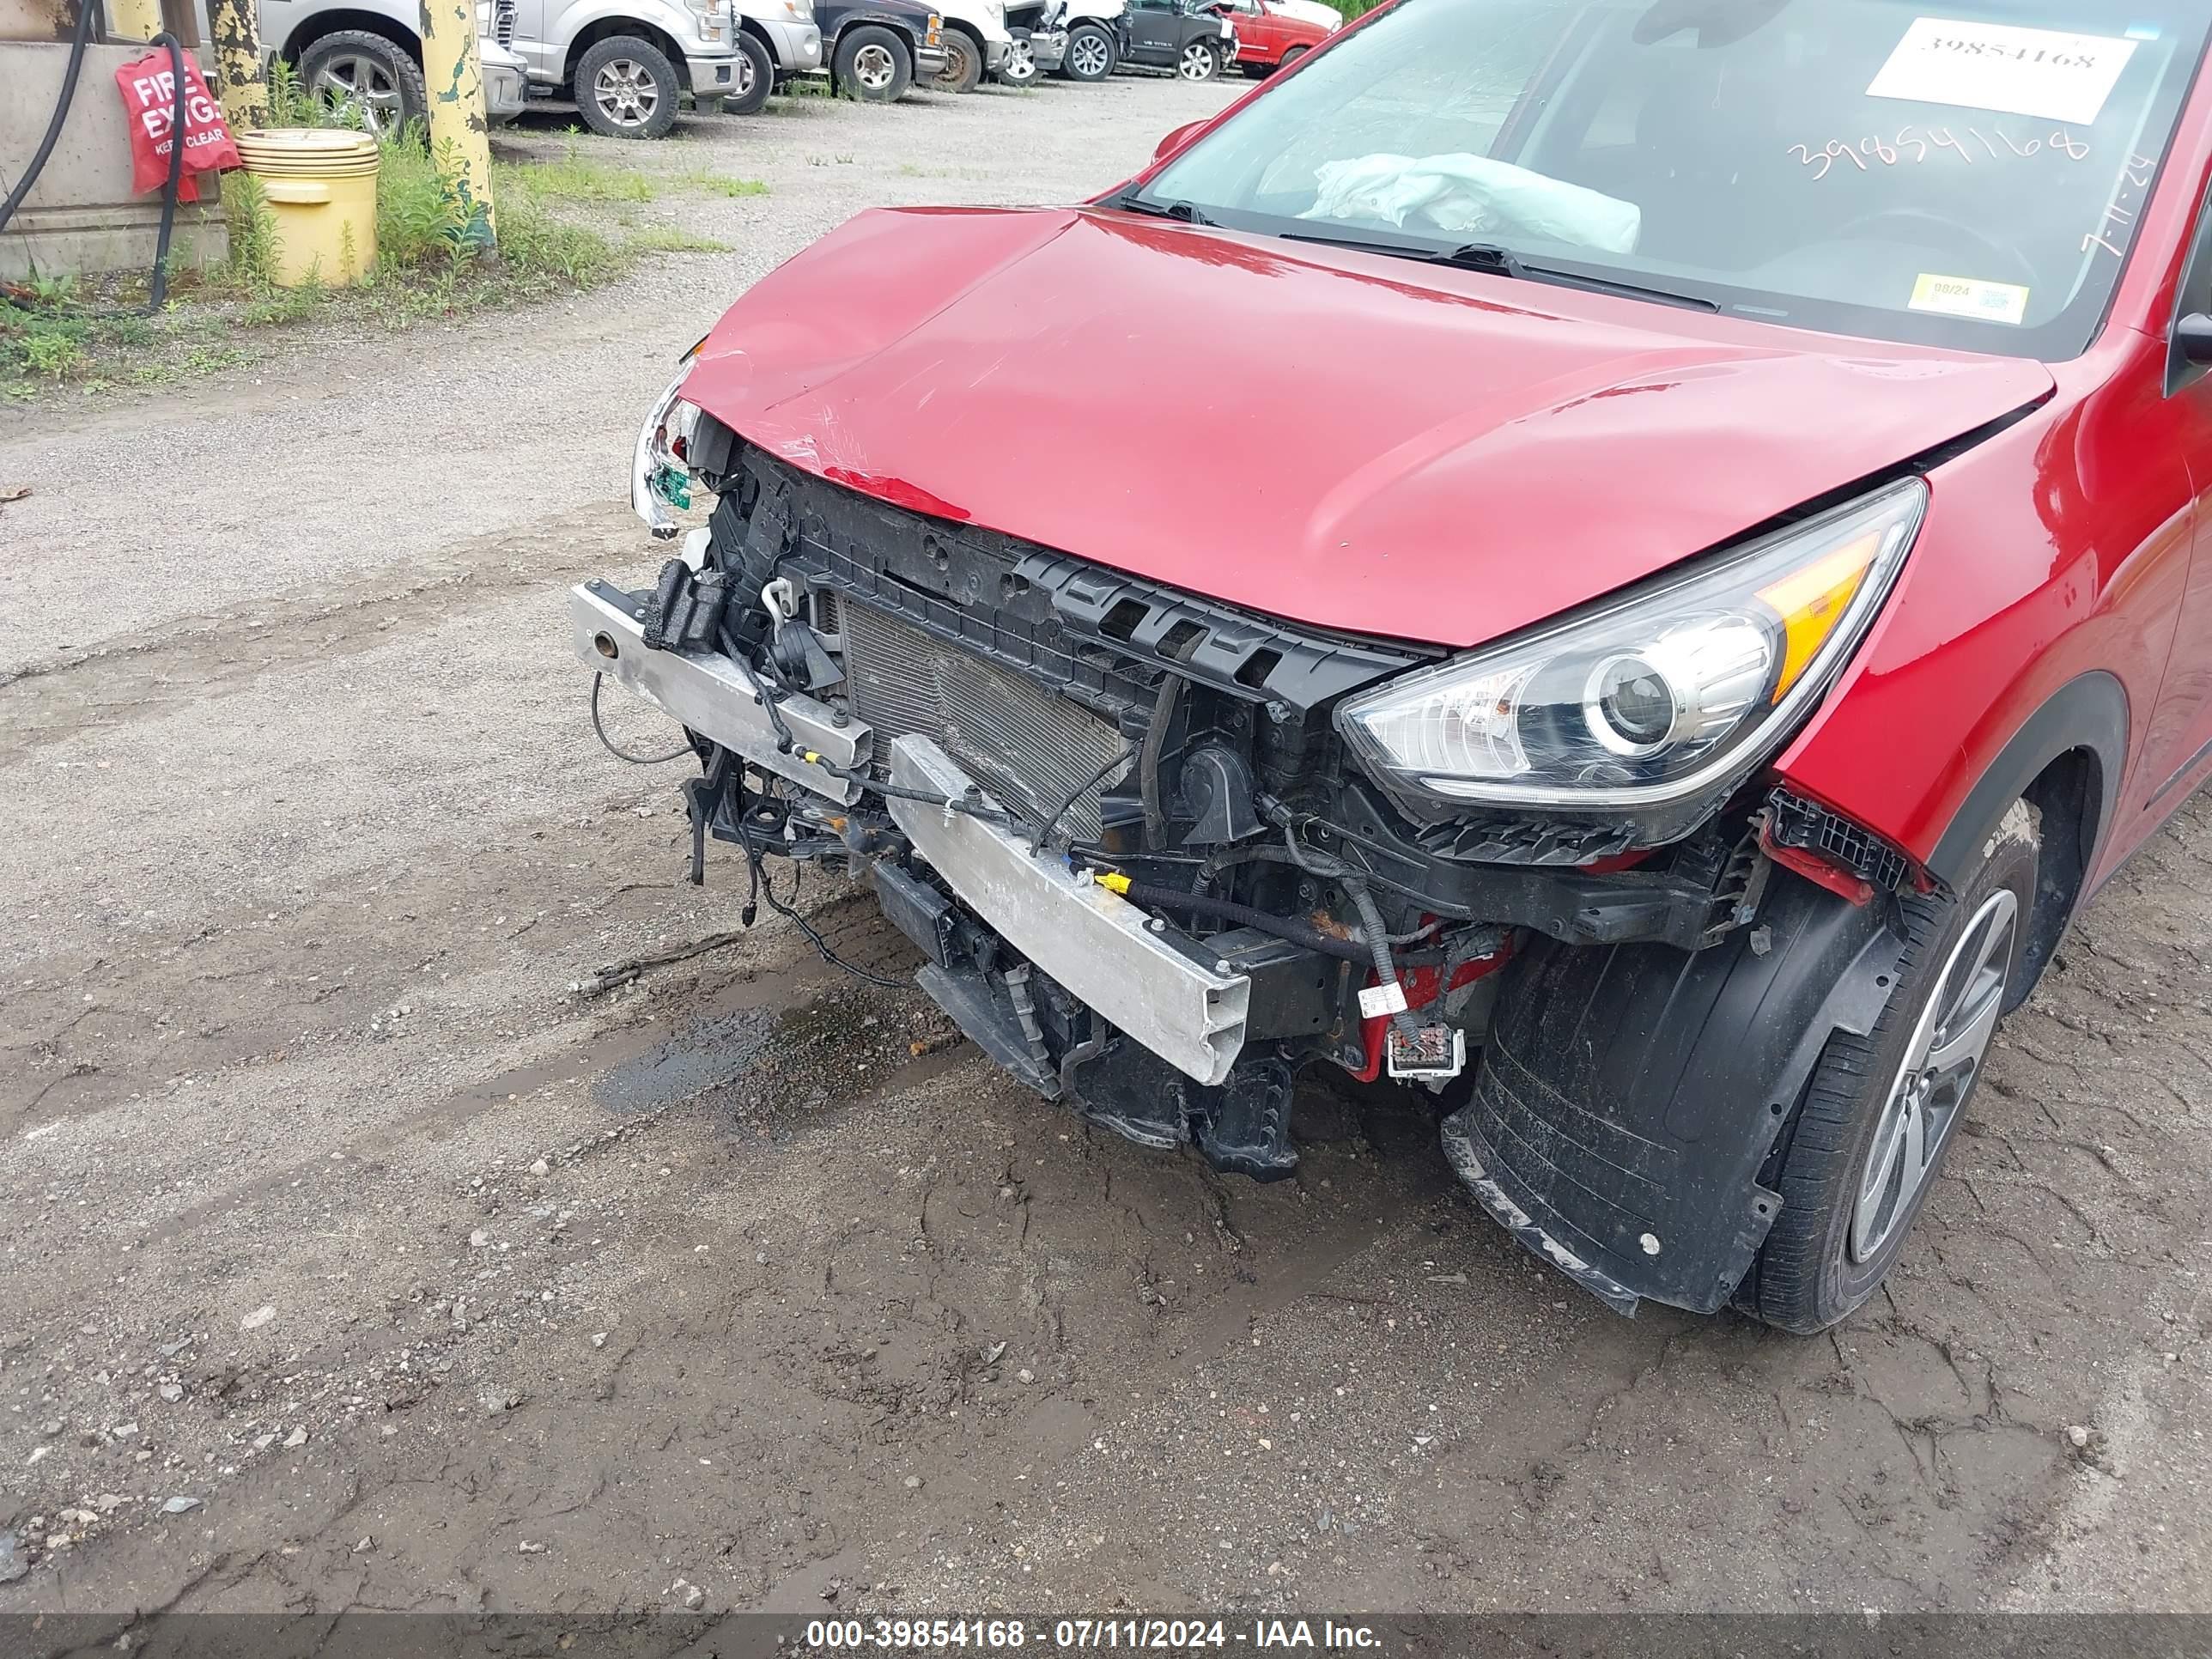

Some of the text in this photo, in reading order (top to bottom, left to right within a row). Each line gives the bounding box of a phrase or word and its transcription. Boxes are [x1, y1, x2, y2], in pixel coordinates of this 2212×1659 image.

[1921, 38, 2095, 68] 39854168
[185, 128, 225, 148] CLEAR
[1787, 125, 2090, 181] 39854168
